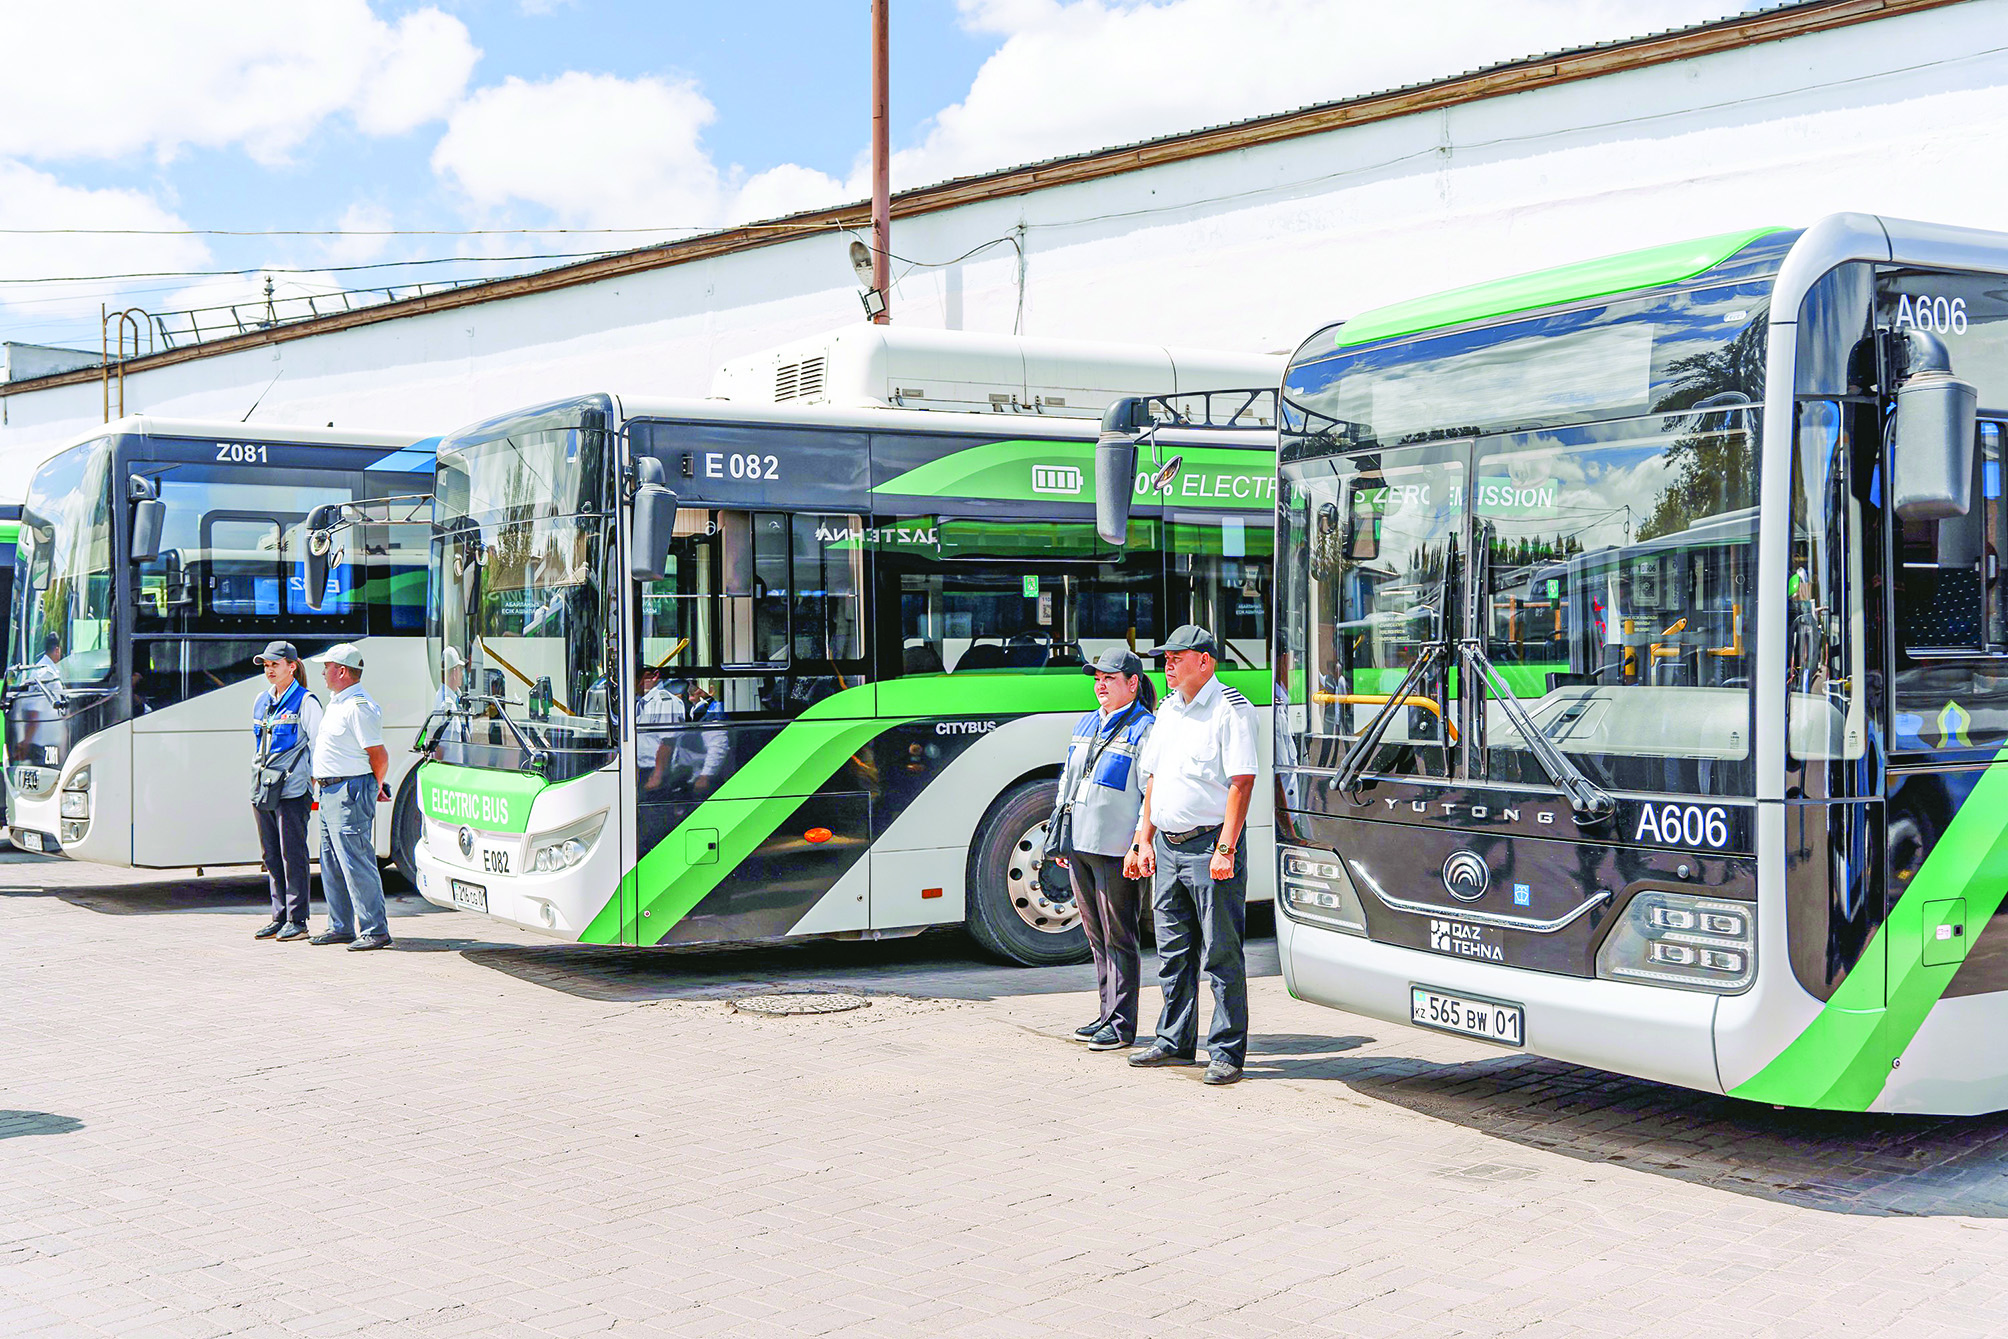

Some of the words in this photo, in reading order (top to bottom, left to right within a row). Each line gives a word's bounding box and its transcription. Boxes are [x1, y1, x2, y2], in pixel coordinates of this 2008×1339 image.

[1895, 293, 1968, 336] A606
[216, 443, 268, 463] Z081
[935, 720, 997, 735] CITYBUS
[431, 787, 480, 820] ELECTRIC
[482, 795, 509, 825] BUS
[1384, 797, 1555, 825] YUTONG
[1635, 803, 1728, 848] A606
[1451, 922, 1481, 941] QAZ
[1451, 939, 1503, 960] TEHNA
[1414, 1007, 1426, 1019] KZ
[1429, 996, 1461, 1026] 565
[1466, 1009, 1487, 1032] BW
[1495, 1010, 1517, 1039] 01
